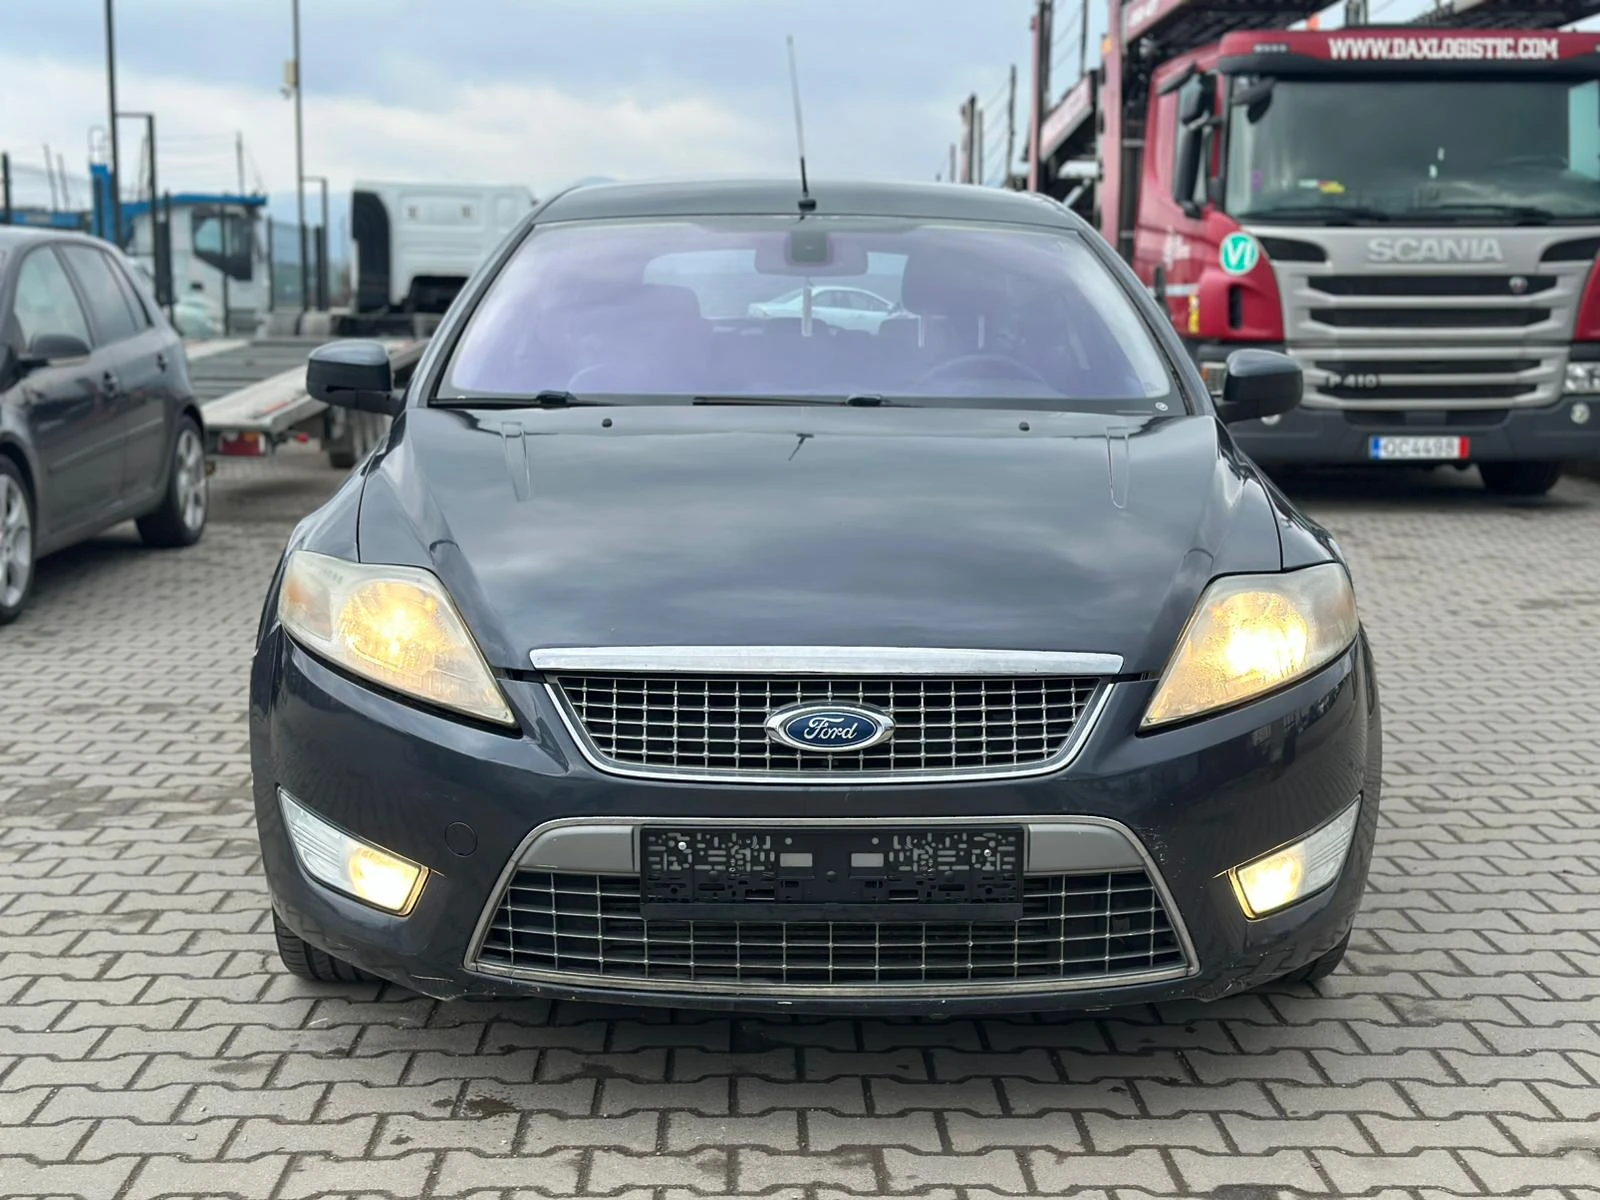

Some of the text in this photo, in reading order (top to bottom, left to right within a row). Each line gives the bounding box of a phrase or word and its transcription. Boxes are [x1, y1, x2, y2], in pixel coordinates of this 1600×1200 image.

[1328, 37, 1559, 60] WWW.DAXLOGISTIC.COM
[1367, 237, 1503, 262] SCANIA
[803, 717, 858, 740] Ford
